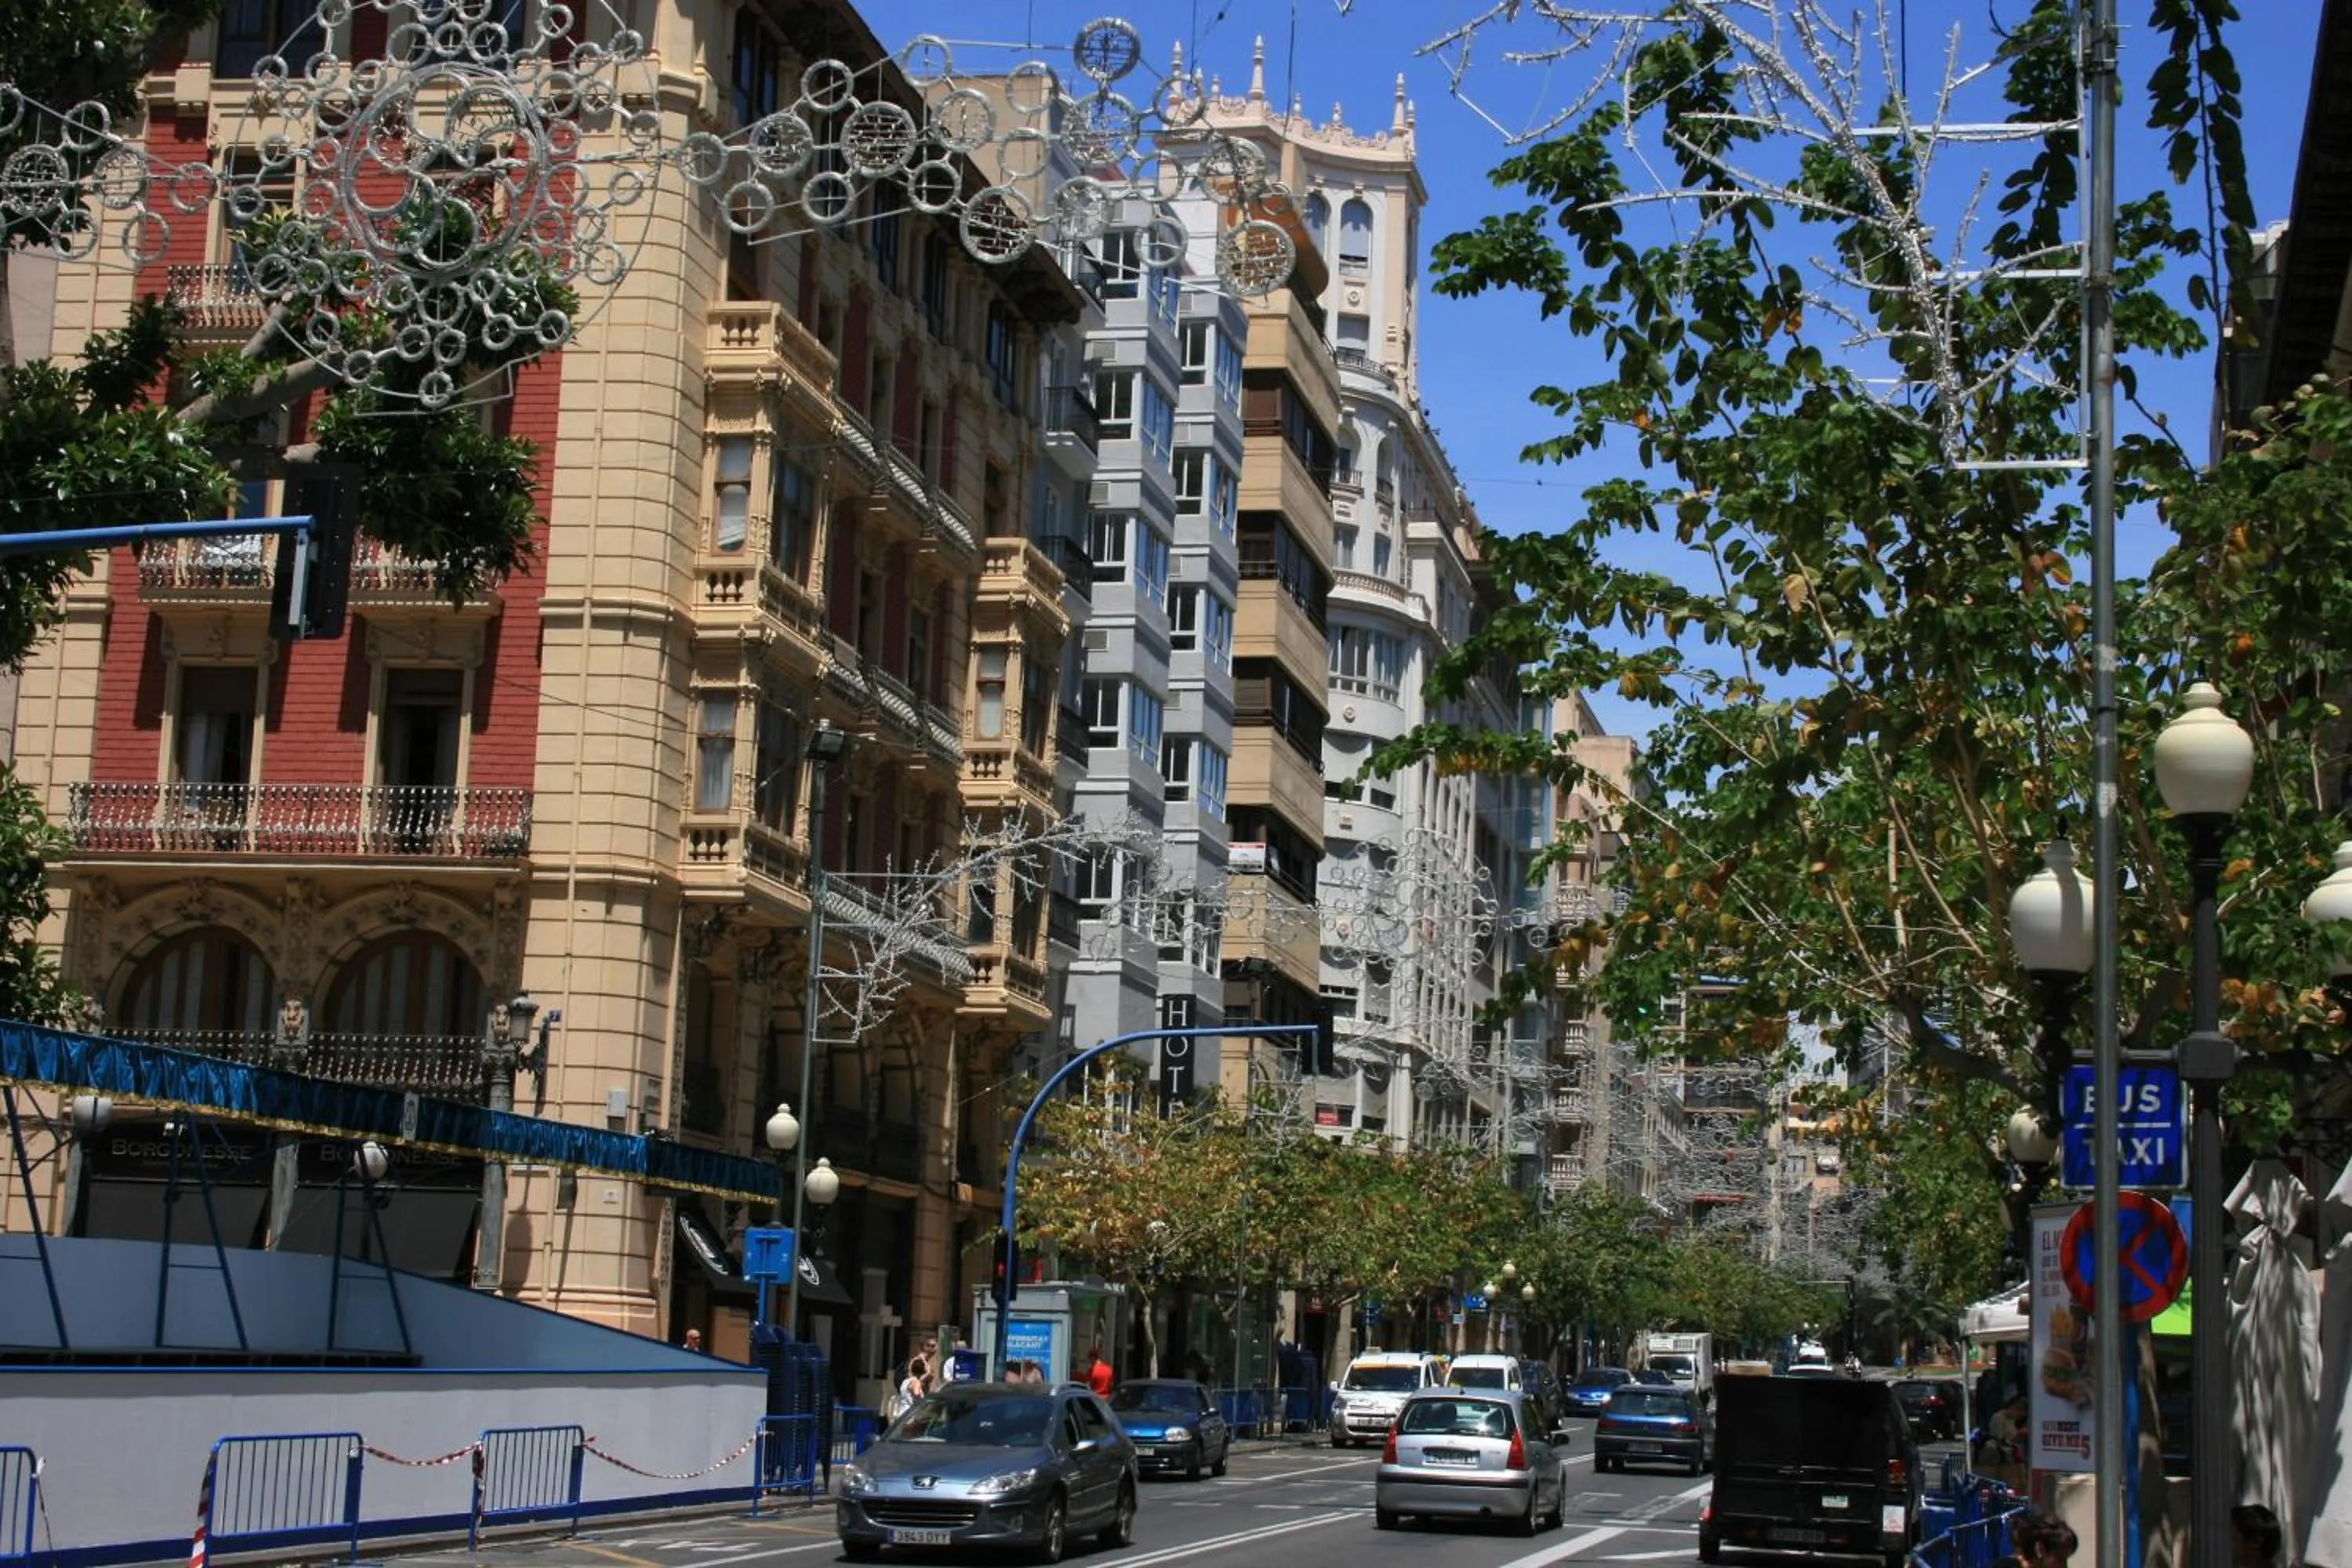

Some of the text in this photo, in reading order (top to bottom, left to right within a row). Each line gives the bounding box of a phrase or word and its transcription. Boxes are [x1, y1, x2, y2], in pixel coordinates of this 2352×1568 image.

[1166, 1000, 1188, 1119] HOTE
[2083, 1083, 2161, 1112] BUS
[321, 1144, 462, 1166] BOONESSE
